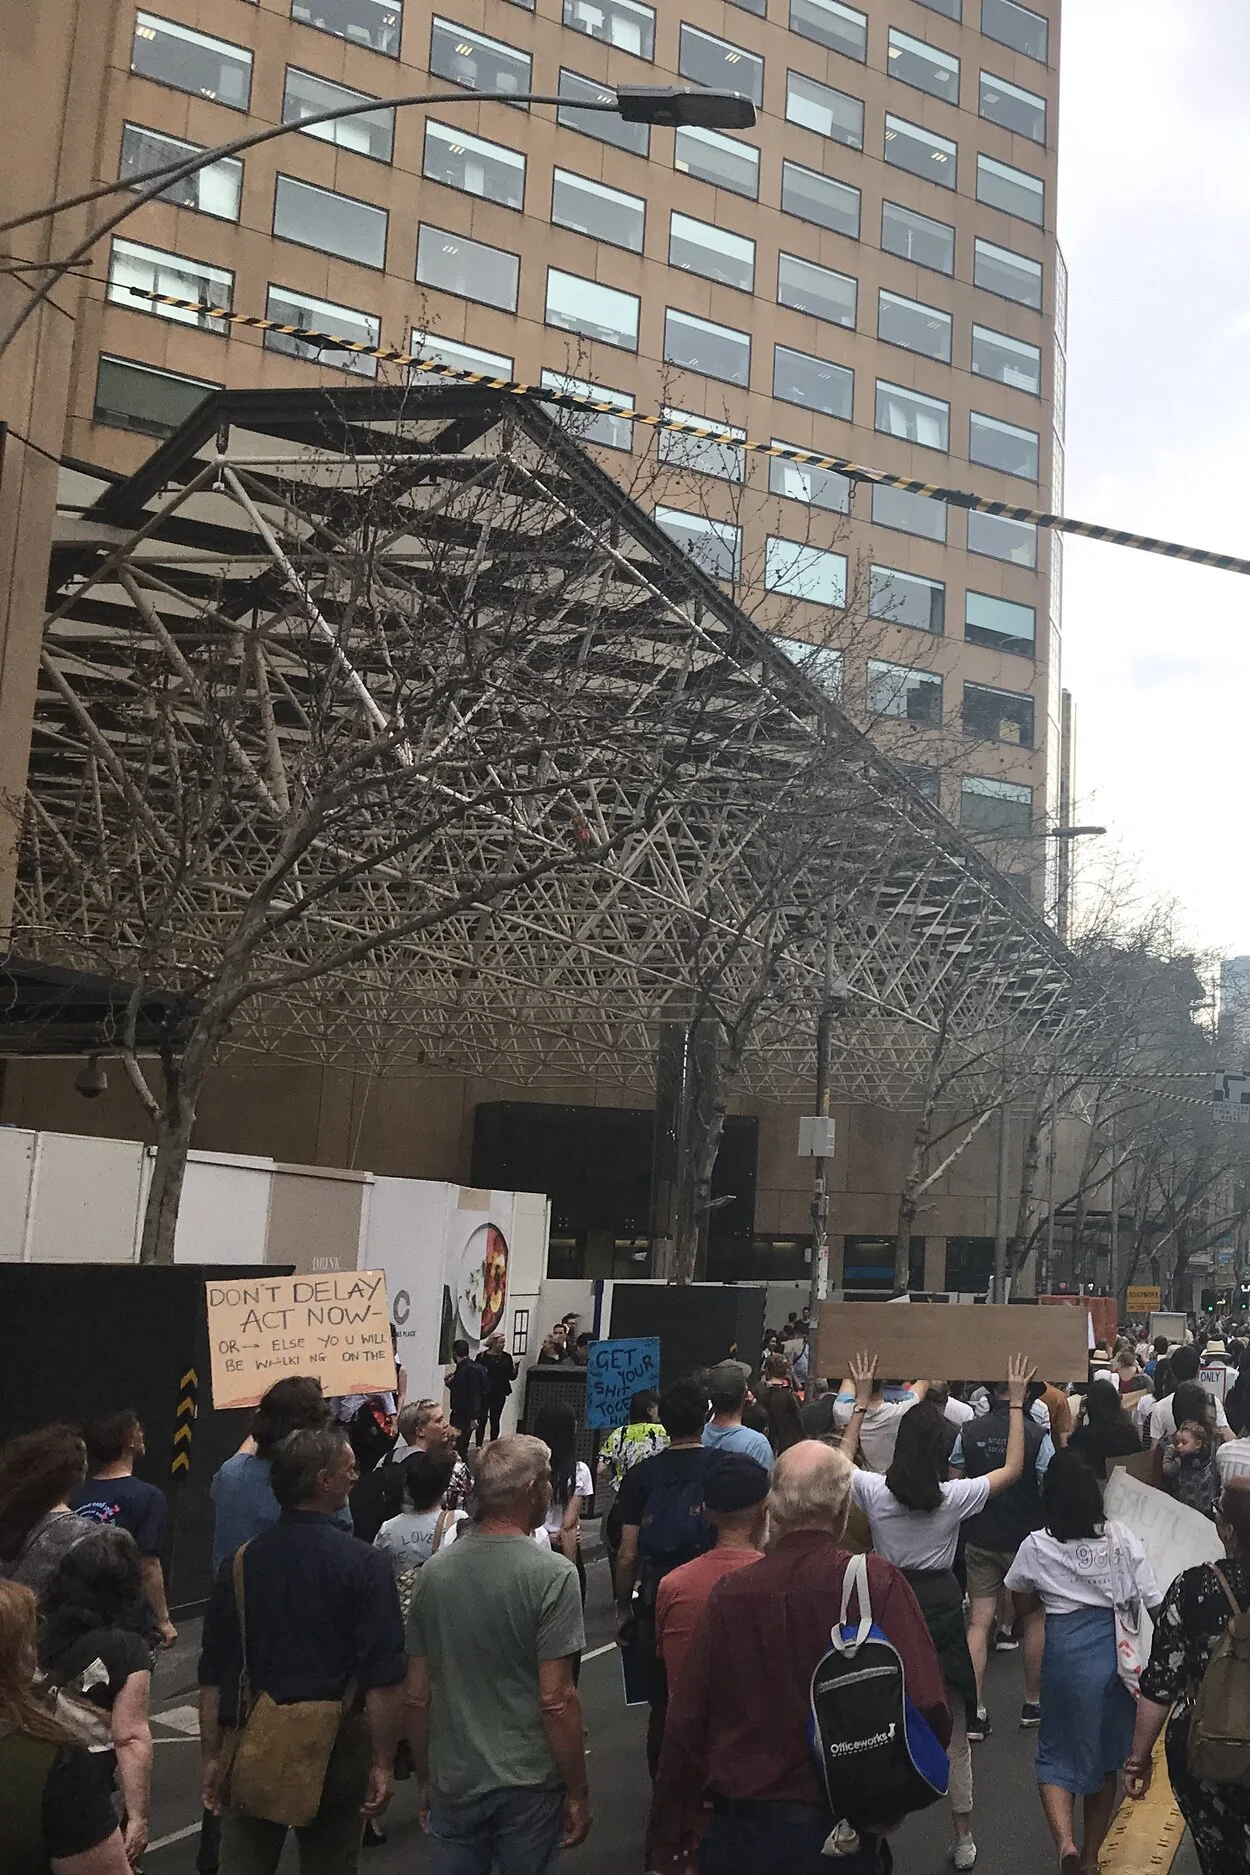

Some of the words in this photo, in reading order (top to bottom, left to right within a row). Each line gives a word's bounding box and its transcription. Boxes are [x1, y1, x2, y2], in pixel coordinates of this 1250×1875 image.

[209, 1283, 281, 1307] DON'T
[293, 1277, 382, 1304] DELAY
[240, 1309, 295, 1334] ACT
[218, 1340, 240, 1355] OR
[272, 1338, 305, 1351] ELSE
[361, 1334, 387, 1345] WILL
[225, 1359, 244, 1372] BE
[342, 1350, 359, 1361] ON
[365, 1350, 386, 1361] THE
[595, 1348, 637, 1371] GET
[617, 1354, 654, 1386] YOUR
[1200, 1371, 1221, 1383] ONLY
[594, 1381, 631, 1398] SHIT
[595, 1397, 632, 1418] TOGE
[401, 1531, 434, 1546] LOVE
[830, 1732, 888, 1755] Officeworks
